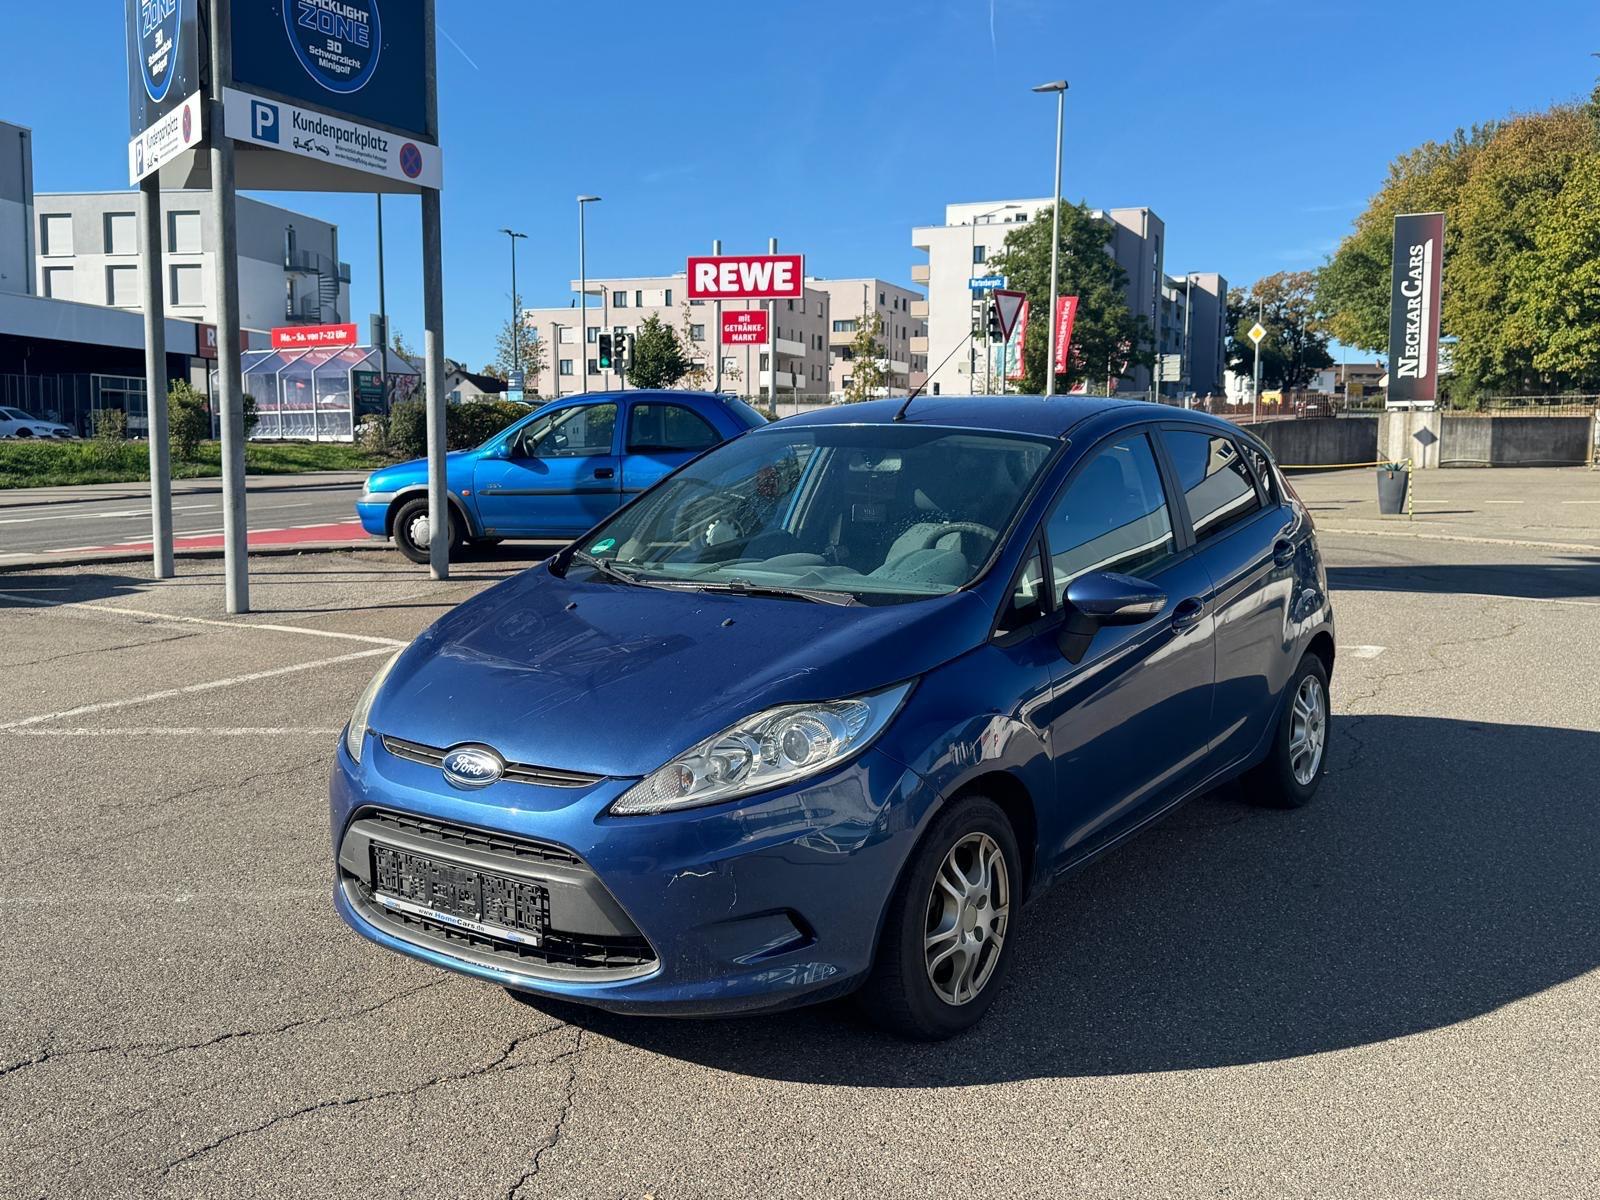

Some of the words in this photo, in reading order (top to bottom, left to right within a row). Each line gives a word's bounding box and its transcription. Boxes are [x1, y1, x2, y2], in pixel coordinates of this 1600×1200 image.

[301, 0, 369, 23] ACKLIGHT
[298, 2, 369, 48] ZONE
[309, 45, 361, 68] Schwarzlicht
[327, 39, 342, 54] 3D
[319, 58, 351, 75] Minigolf
[256, 104, 274, 137] P
[292, 110, 389, 153] Kundenparkplatz
[695, 261, 794, 292] REWE
[724, 322, 764, 332] GETRÄNKE-
[738, 313, 750, 322] mit
[307, 333, 319, 341] von
[335, 331, 347, 340] Uhr
[731, 333, 757, 341] MARKT
[1056, 300, 1072, 361] Abholservice
[452, 754, 486, 776] Ford
[418, 908, 485, 932] www.HomeCars.de
